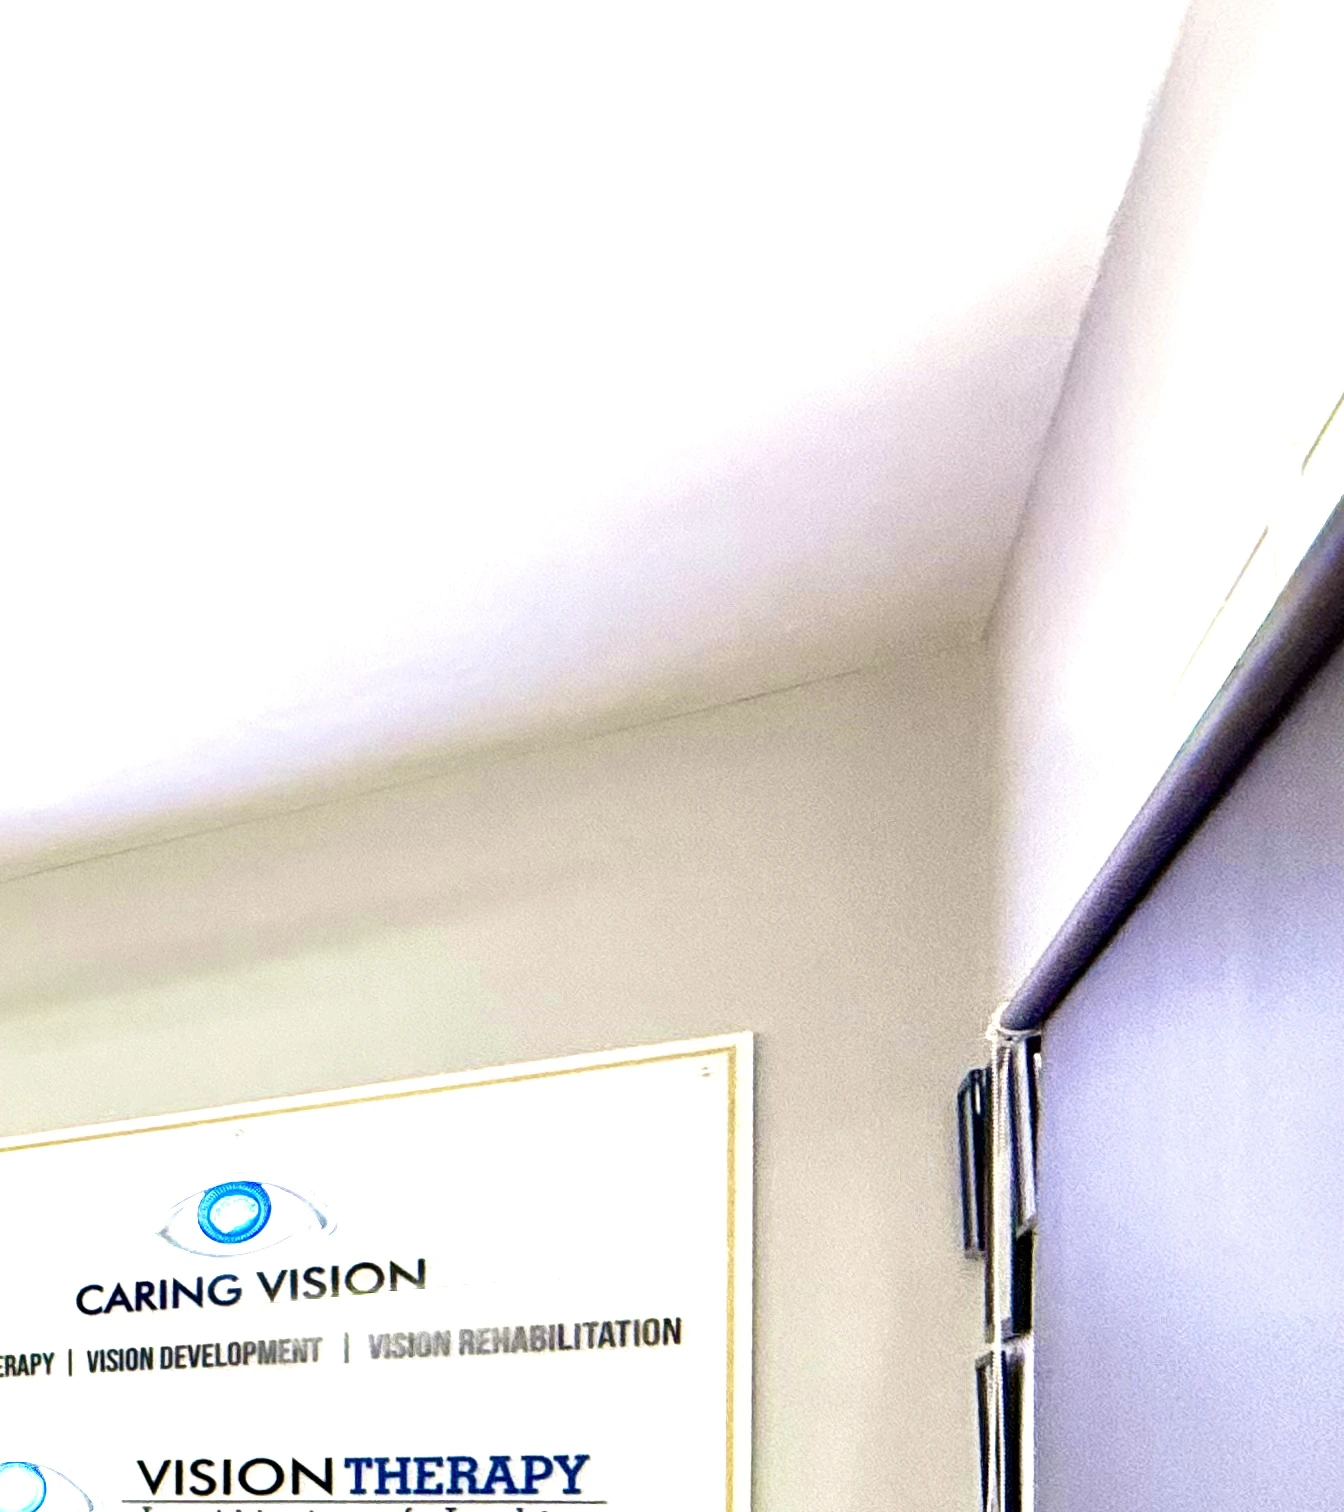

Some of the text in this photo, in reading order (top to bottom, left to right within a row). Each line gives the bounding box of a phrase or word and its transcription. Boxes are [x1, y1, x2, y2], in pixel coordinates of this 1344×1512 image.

[75, 1257, 427, 1317] CARING VISION
[86, 1336, 323, 1374] VISION DEVELOPMENT
[368, 1316, 683, 1360] VISION REHABILITATION
[136, 1453, 591, 1497] VISION THERAPY
